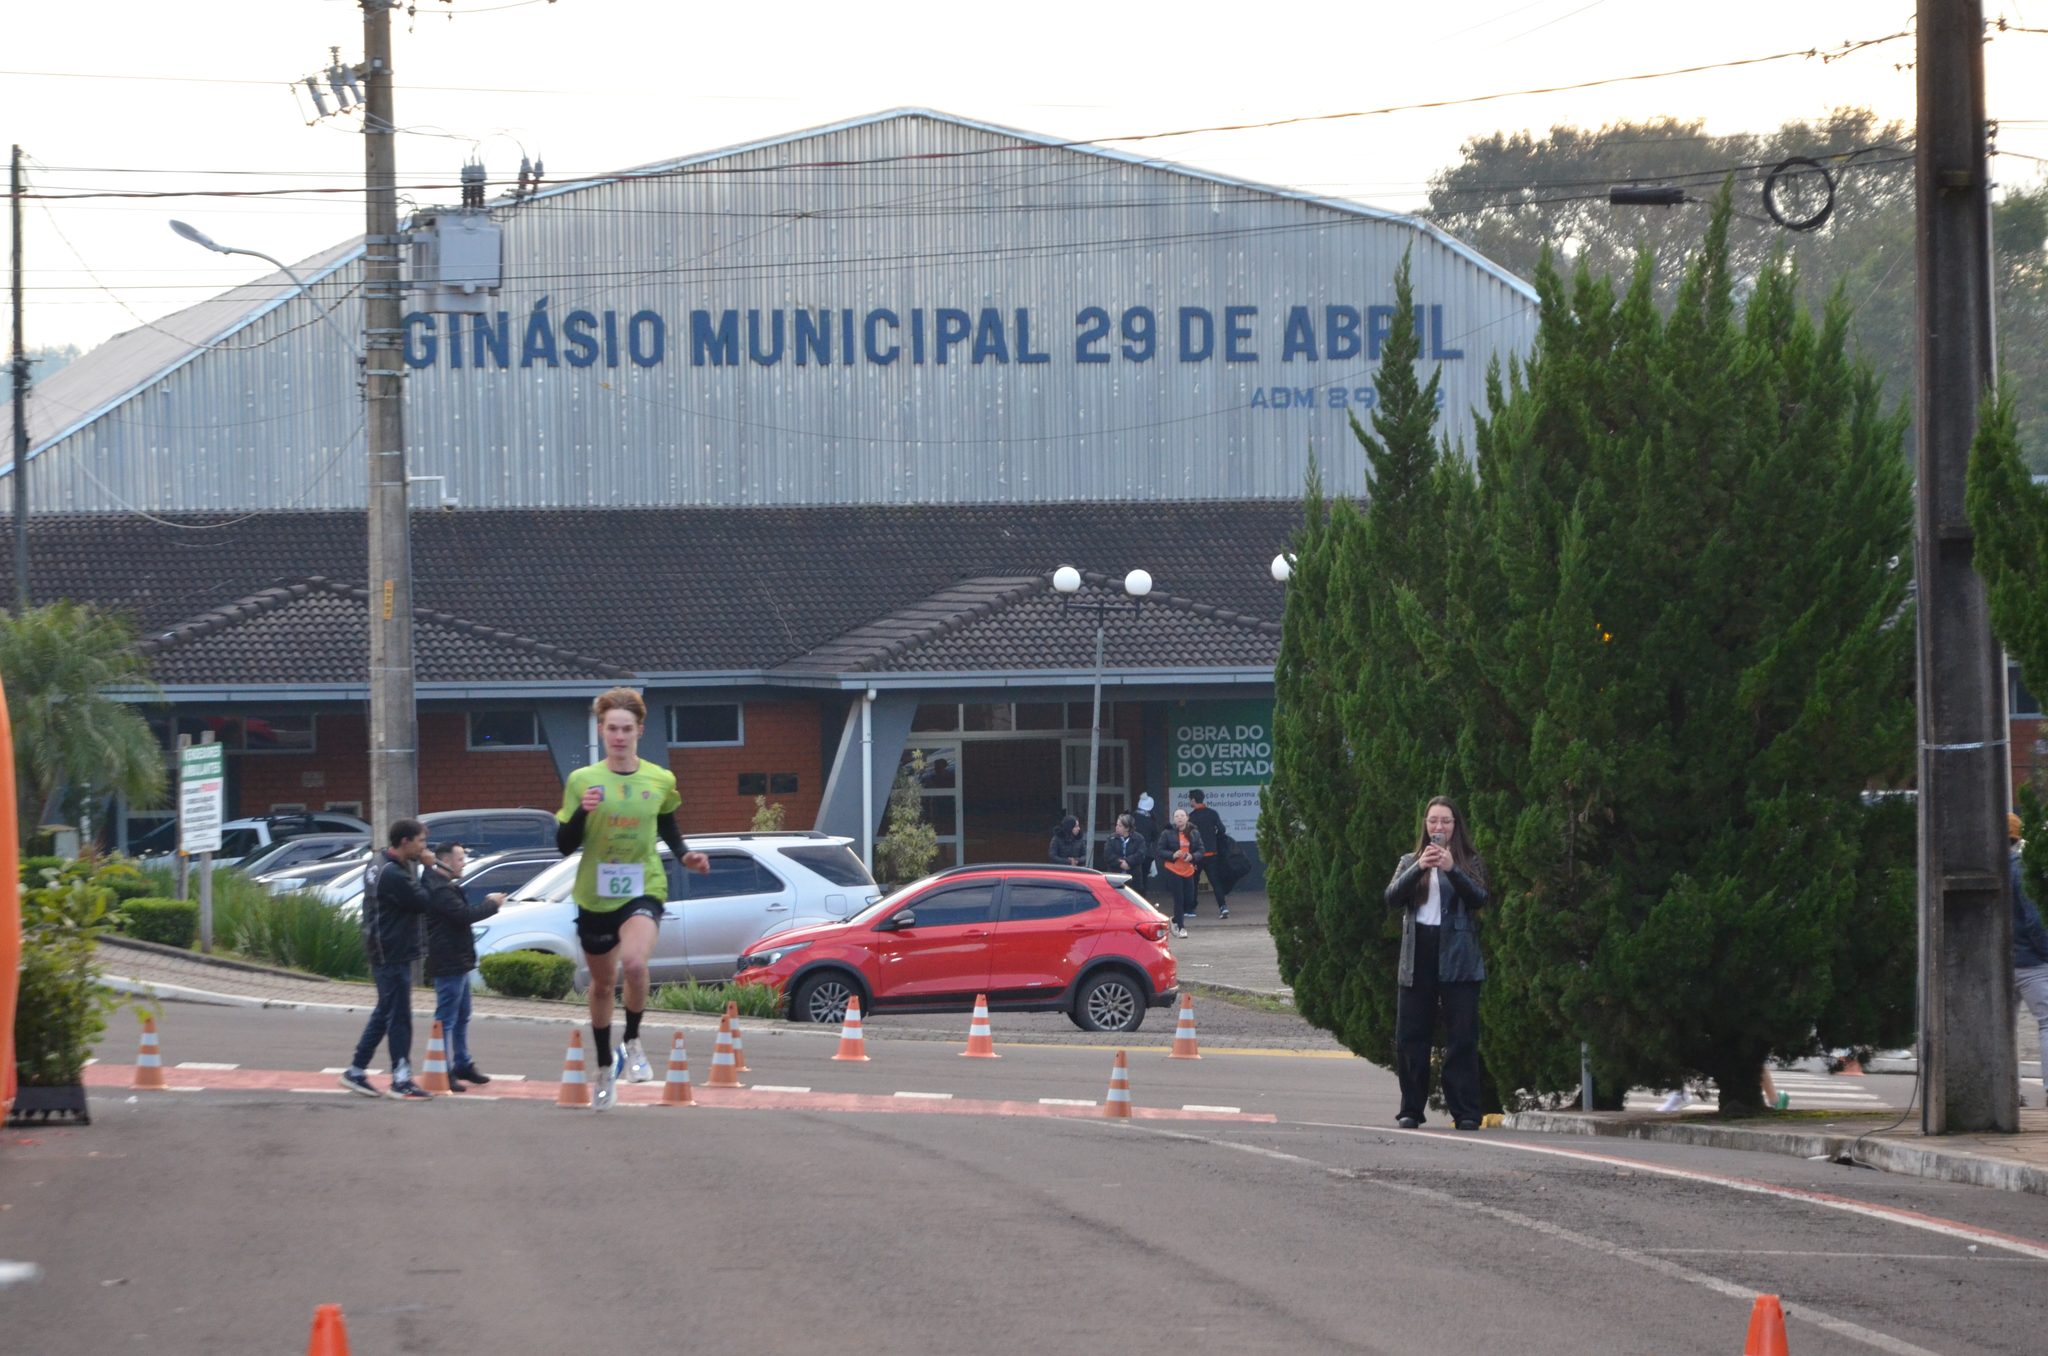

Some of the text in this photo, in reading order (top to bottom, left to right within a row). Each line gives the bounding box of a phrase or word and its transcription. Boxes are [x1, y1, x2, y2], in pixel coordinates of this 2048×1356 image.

[402, 295, 666, 369] GINÁSIO
[691, 306, 1051, 368] MUNICIPAL
[1076, 305, 1157, 364] 29
[1179, 304, 1259, 363] DE
[1251, 386, 1316, 409] ADM
[1177, 725, 1264, 742] OBRA DO
[1177, 743, 1271, 759] GOVERNO
[1177, 760, 1275, 777] DO ESTAD
[1206, 799, 1242, 807] Municipal
[1226, 791, 1256, 799] reforma
[609, 876, 633, 895] 62
